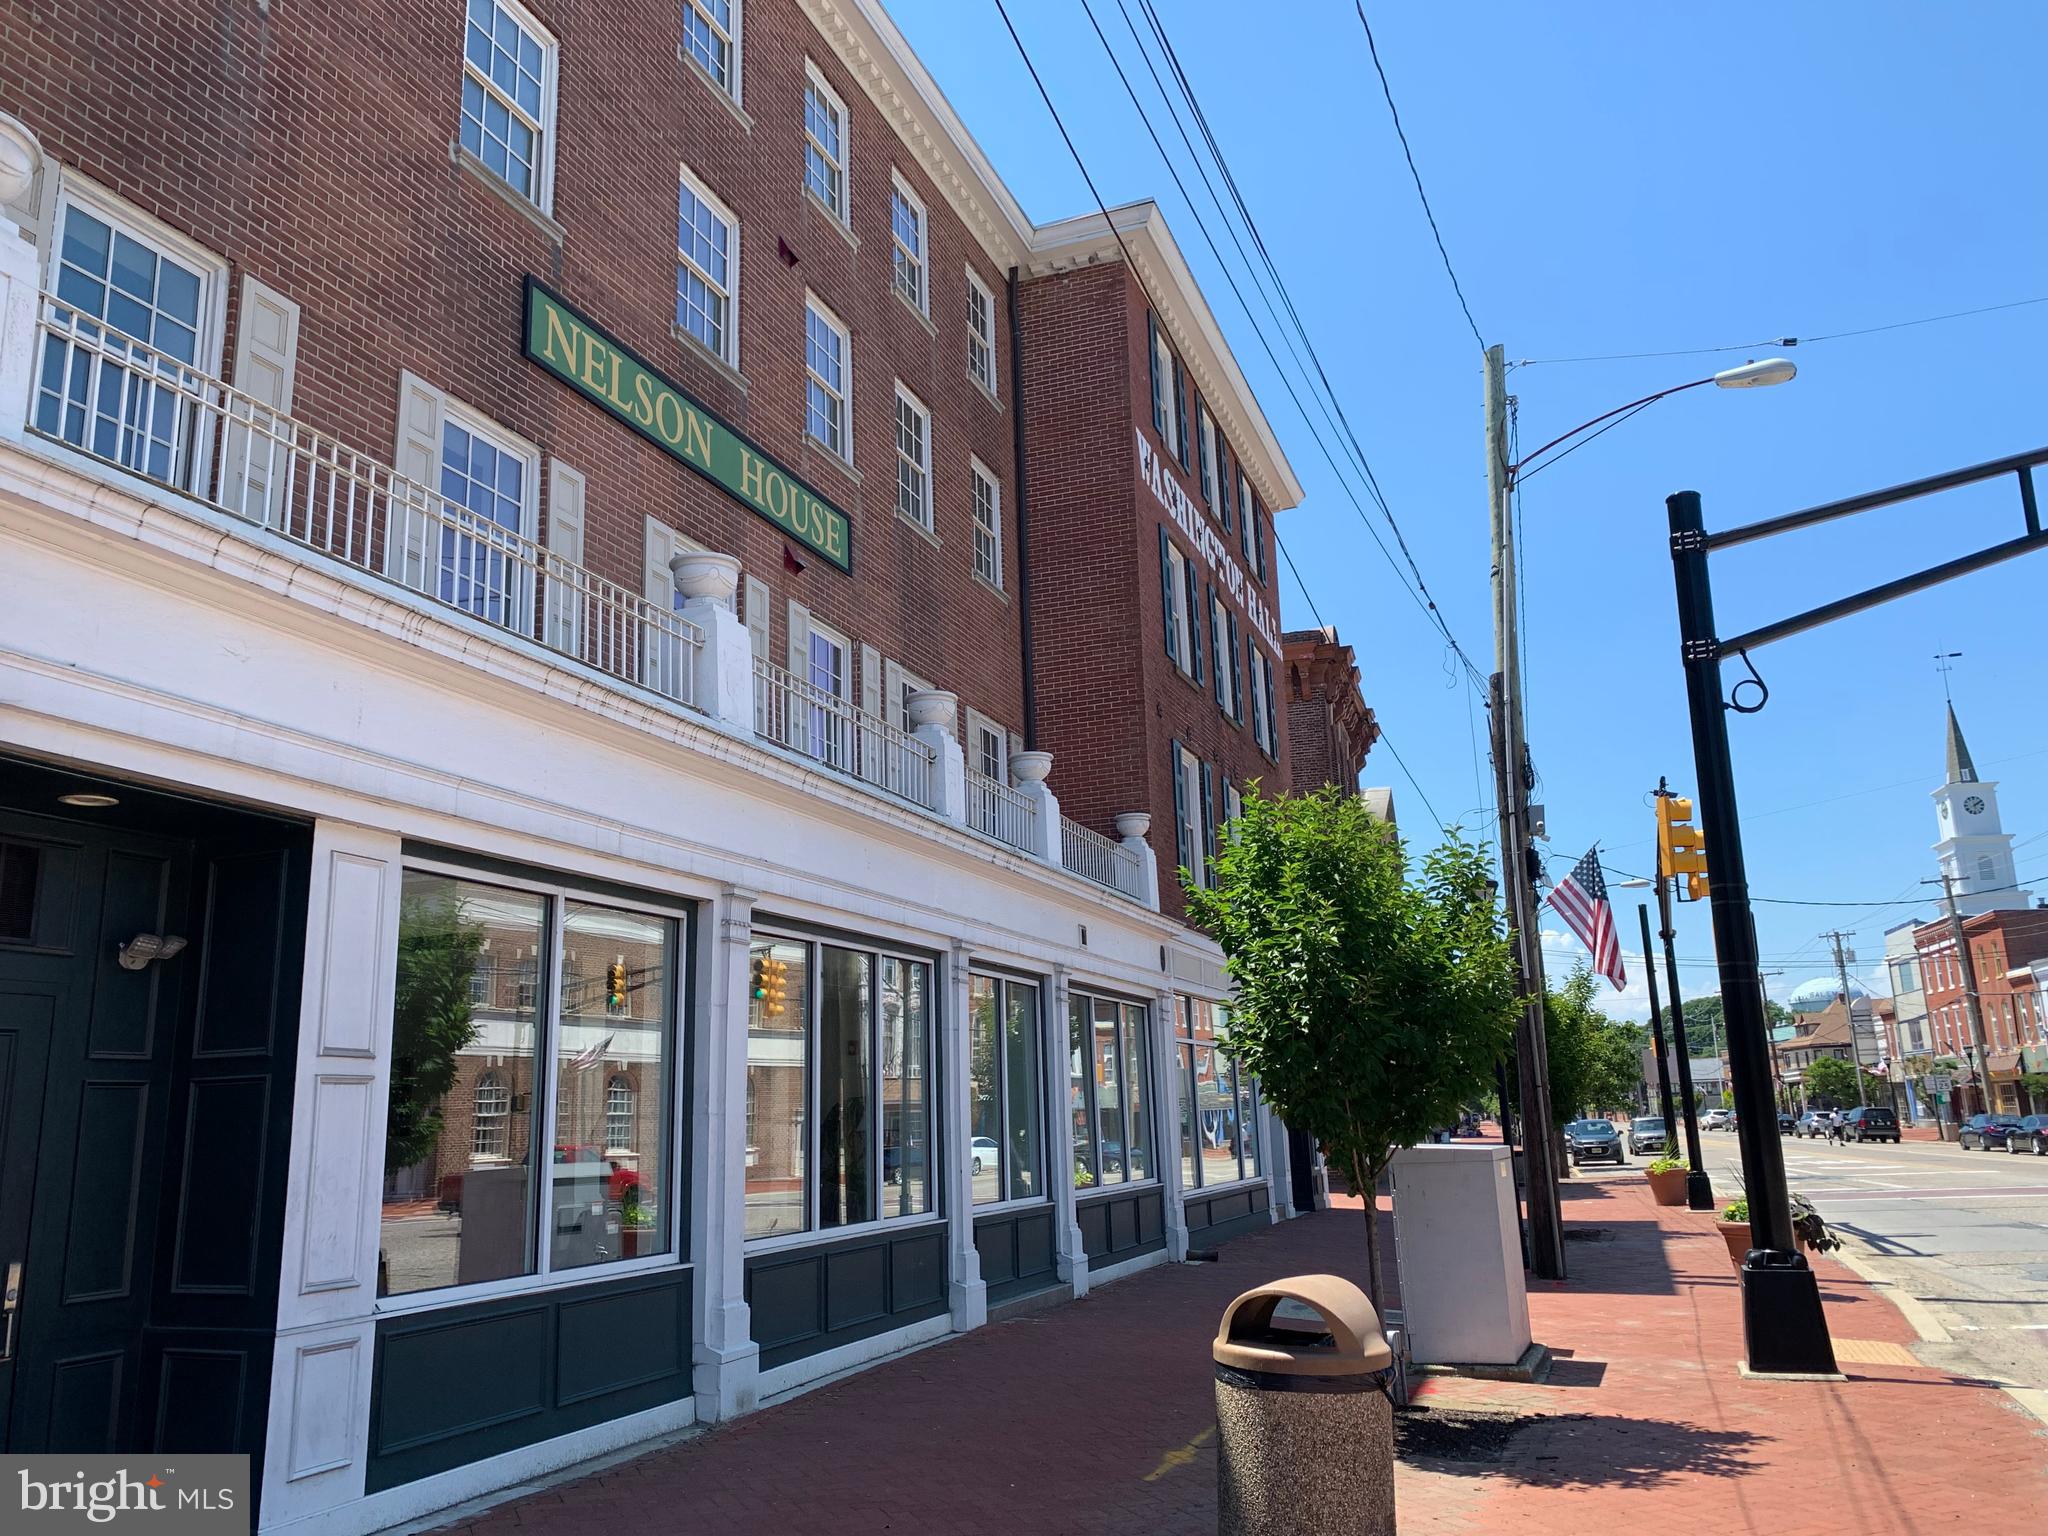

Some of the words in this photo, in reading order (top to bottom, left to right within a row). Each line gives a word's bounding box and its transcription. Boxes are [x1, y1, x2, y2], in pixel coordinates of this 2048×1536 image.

[543, 303, 713, 468] NELSON
[739, 447, 841, 559] HOUSE
[1135, 426, 1244, 609] WASHINGTON
[1246, 580, 1283, 662] HALL
[1939, 1082, 1950, 1090] 25
